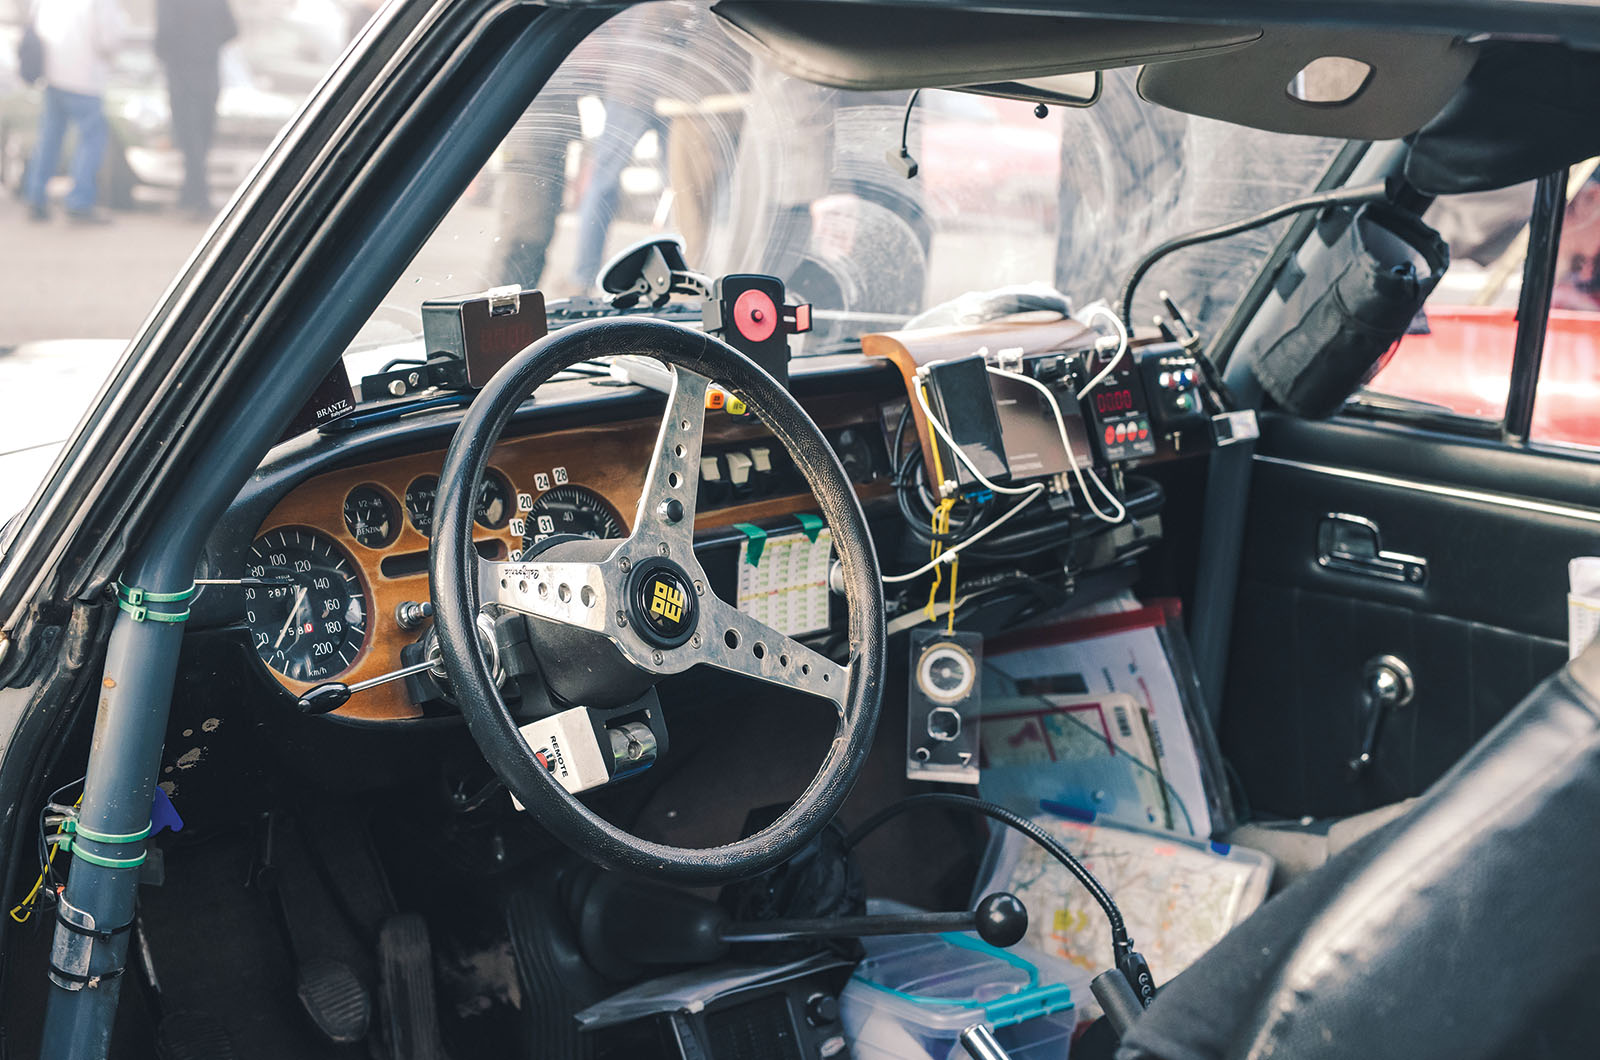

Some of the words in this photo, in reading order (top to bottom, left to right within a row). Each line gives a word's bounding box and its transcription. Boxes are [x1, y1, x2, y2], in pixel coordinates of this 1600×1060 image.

[316, 400, 348, 418] BRANTZ
[536, 475, 549, 489] 24
[555, 469, 568, 482] 28
[520, 495, 532, 509] 20
[563, 511, 574, 522] 40
[356, 525, 383, 537] BENZIN
[512, 521, 525, 534] 16
[541, 519, 553, 532] 31
[269, 553, 287, 566] 100
[251, 565, 265, 578] 80
[294, 560, 312, 573] 120
[313, 577, 330, 590] 140
[324, 598, 340, 611] 160
[325, 621, 342, 634] 180
[312, 641, 333, 656] 200
[308, 667, 328, 677] km/h
[550, 735, 569, 778] REMOTE
